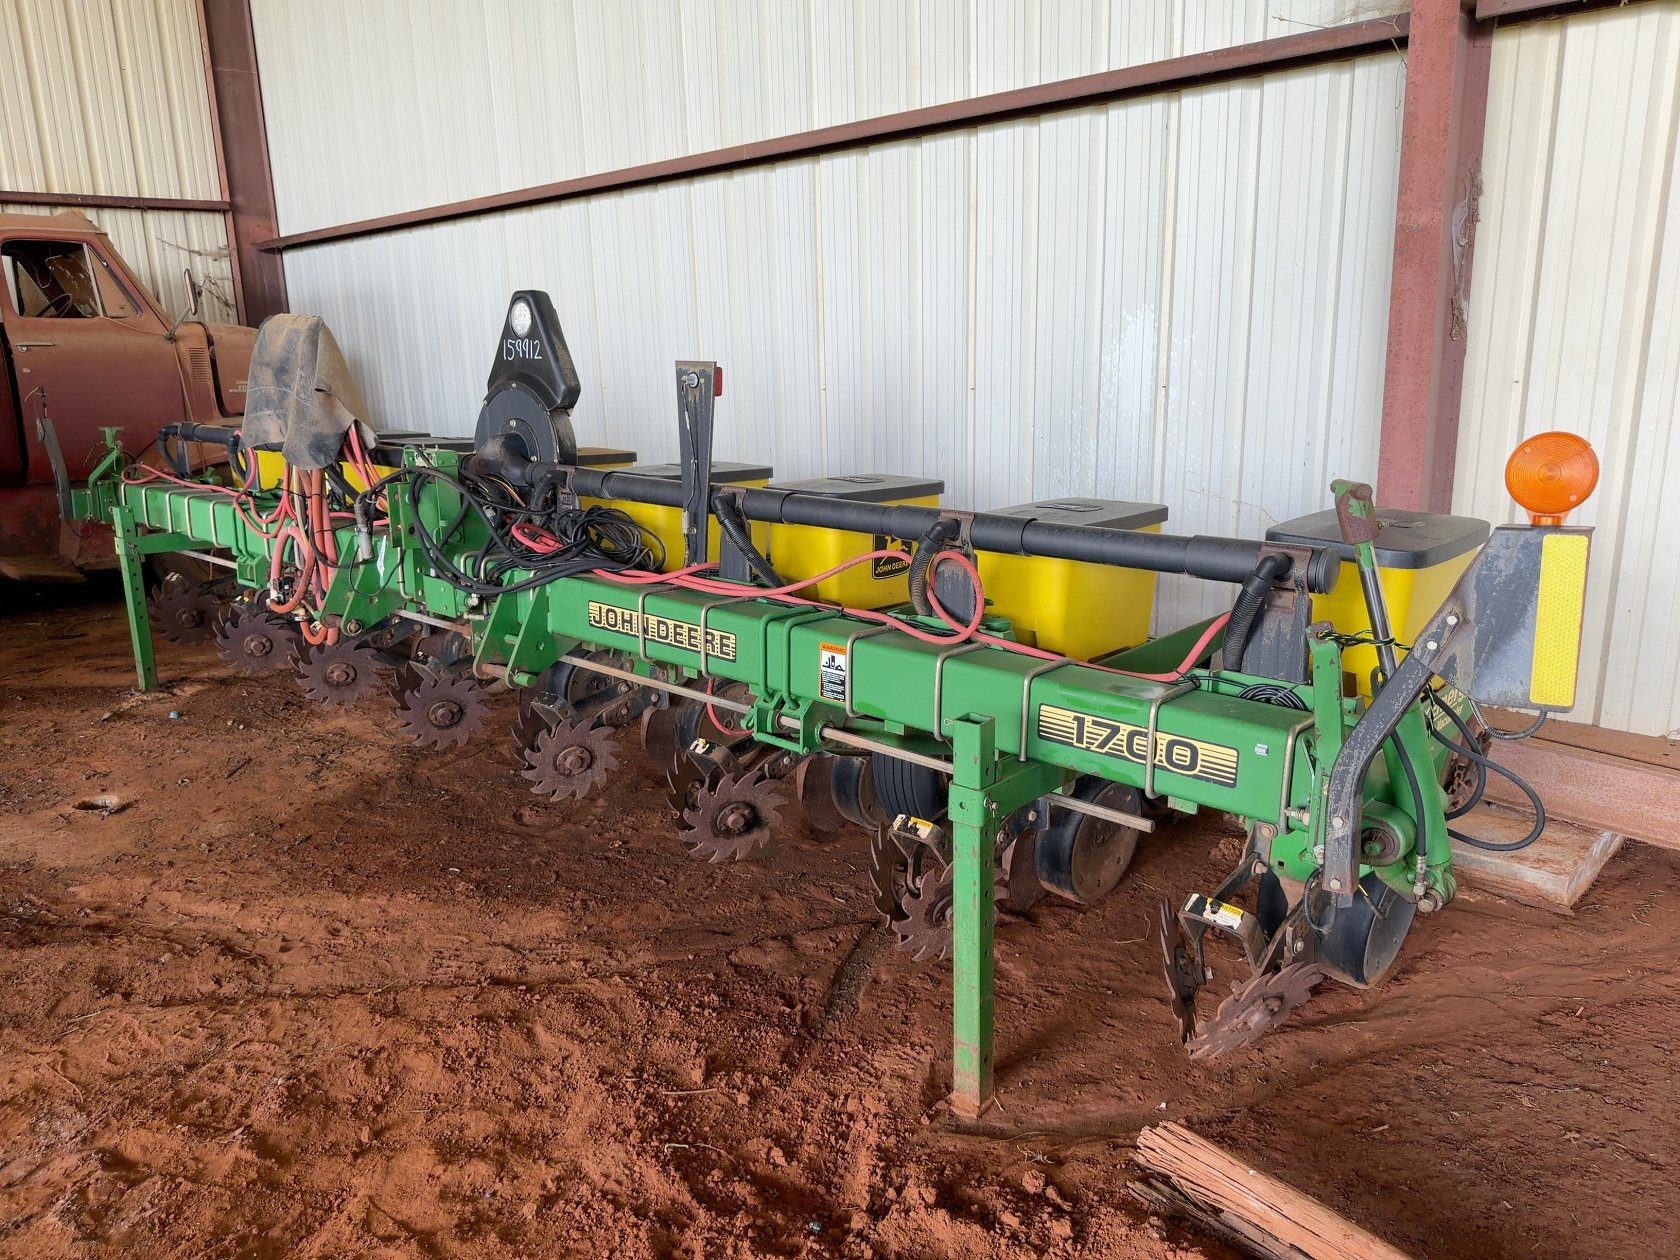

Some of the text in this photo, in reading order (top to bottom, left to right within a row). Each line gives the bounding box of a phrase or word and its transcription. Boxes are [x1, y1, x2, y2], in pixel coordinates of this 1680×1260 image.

[503, 339, 543, 361] 159912
[592, 605, 732, 657] JOHN DEERE
[1071, 714, 1200, 773] 1700
